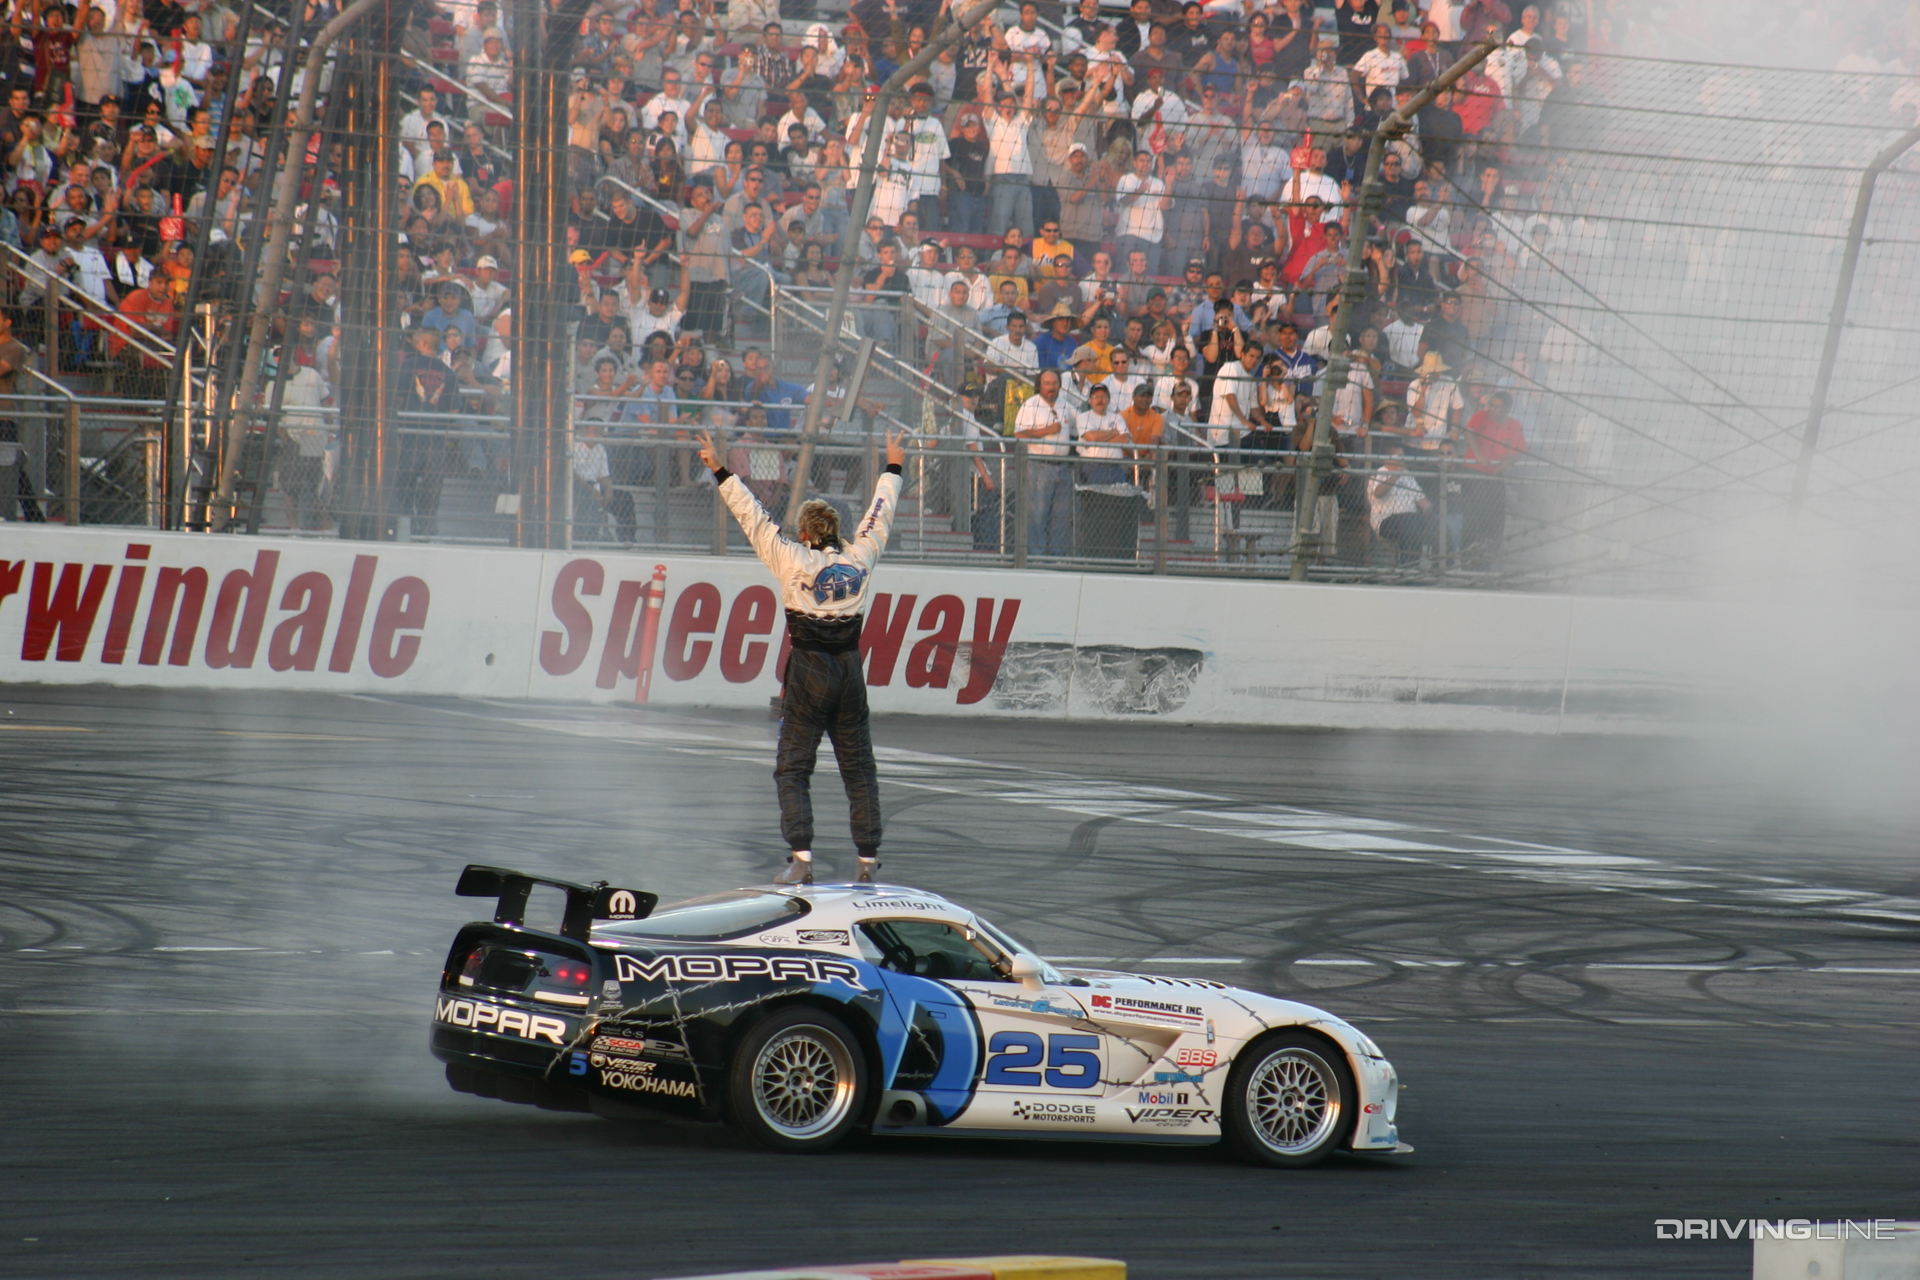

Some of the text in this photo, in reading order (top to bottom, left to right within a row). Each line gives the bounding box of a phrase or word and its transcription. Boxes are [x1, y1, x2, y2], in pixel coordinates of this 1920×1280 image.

[801, 568, 869, 592] MOPAR
[539, 559, 1022, 705] Speeway
[852, 900, 948, 912] Limelight
[614, 954, 868, 991] MOPAR
[1091, 994, 1204, 1016] DC PERFORMANCE INC.
[435, 997, 566, 1045] MOPAR
[1093, 1008, 1201, 1027] www.dcperformanceinc.com
[593, 1044, 610, 1052] PRO
[609, 1046, 640, 1055] RACING
[608, 1038, 642, 1050] SCCA
[606, 1056, 657, 1070] VIPER
[984, 1030, 1101, 1089] 25
[1176, 1048, 1218, 1067] BBS
[600, 1070, 696, 1098] YOKOHAMA
[1138, 1091, 1174, 1105] Mobil
[1032, 1102, 1097, 1114] DODGE
[1124, 1107, 1216, 1124] VIPER
[1032, 1113, 1097, 1124] MOTORSPORTS
